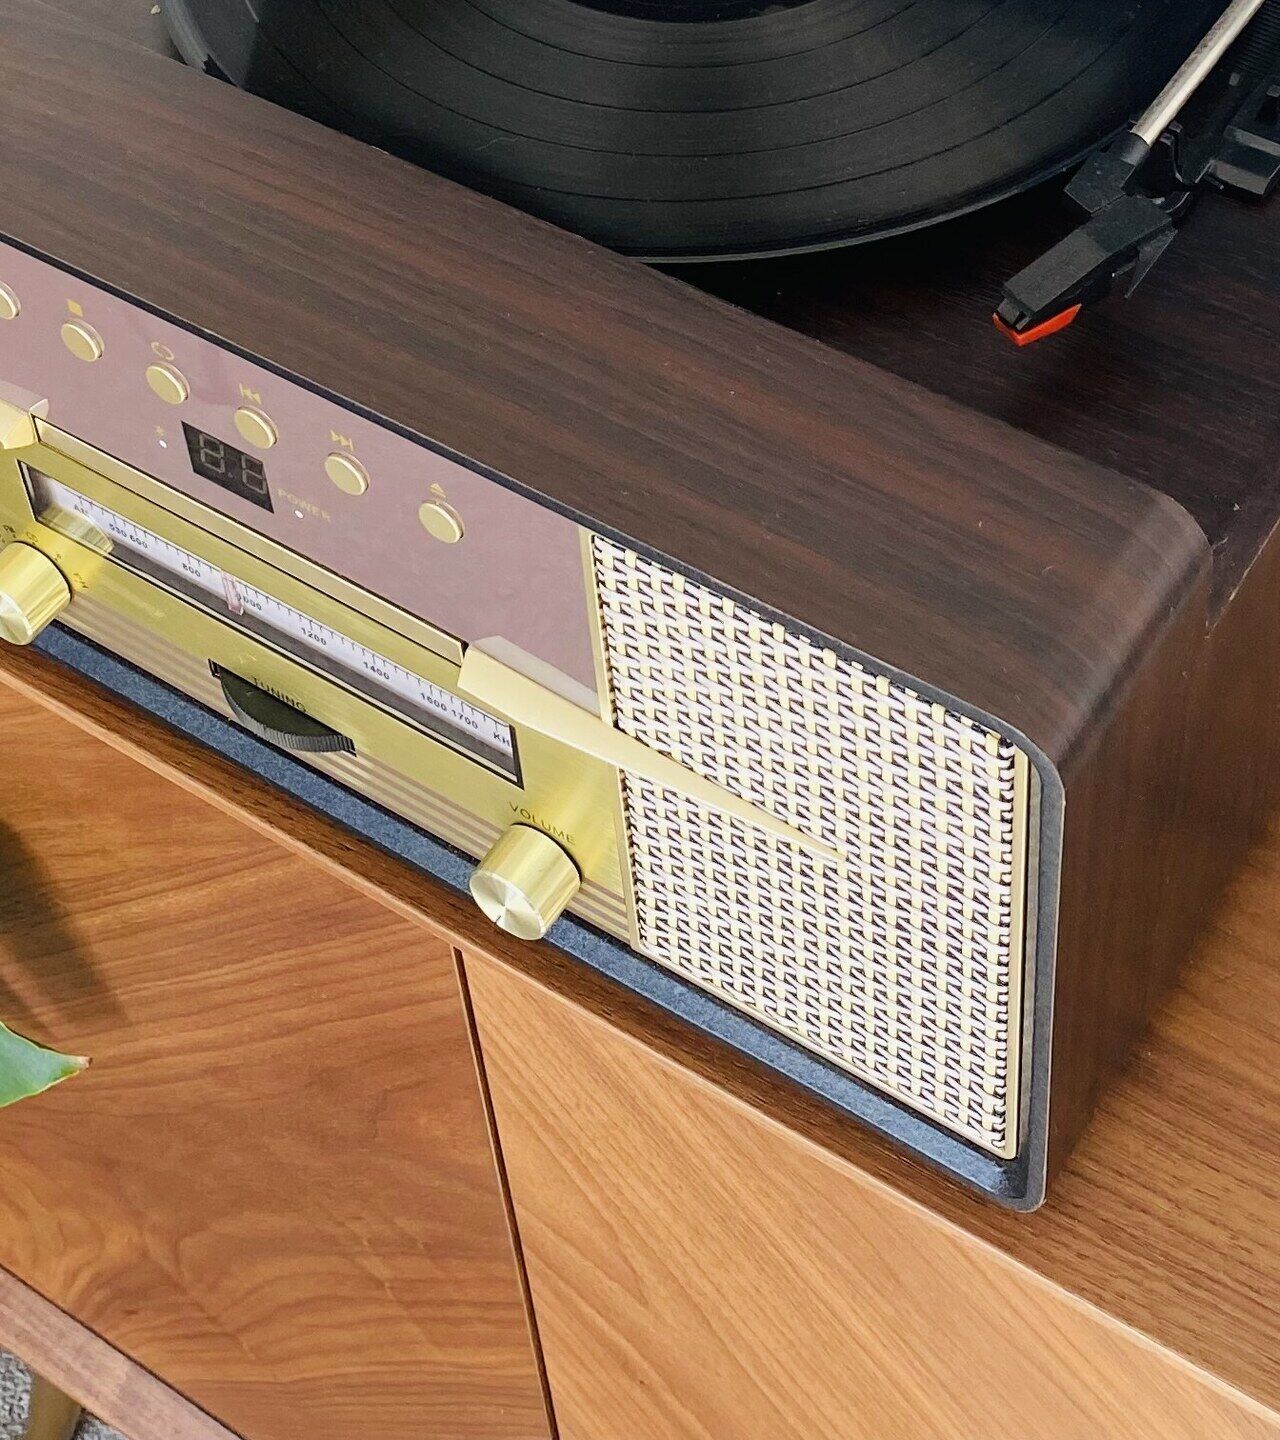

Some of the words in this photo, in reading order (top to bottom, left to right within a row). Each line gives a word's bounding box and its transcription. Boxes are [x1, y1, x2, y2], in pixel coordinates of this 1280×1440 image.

[278, 488, 332, 523] POWER
[108, 523, 128, 538] 530
[129, 534, 149, 549] 600
[182, 562, 202, 578] 800
[301, 627, 328, 646] 1200
[363, 661, 390, 680] 1400
[420, 692, 447, 712] 1600
[451, 709, 479, 730] 1700
[252, 675, 307, 713] TUNING
[507, 799, 576, 846] VOLUME
